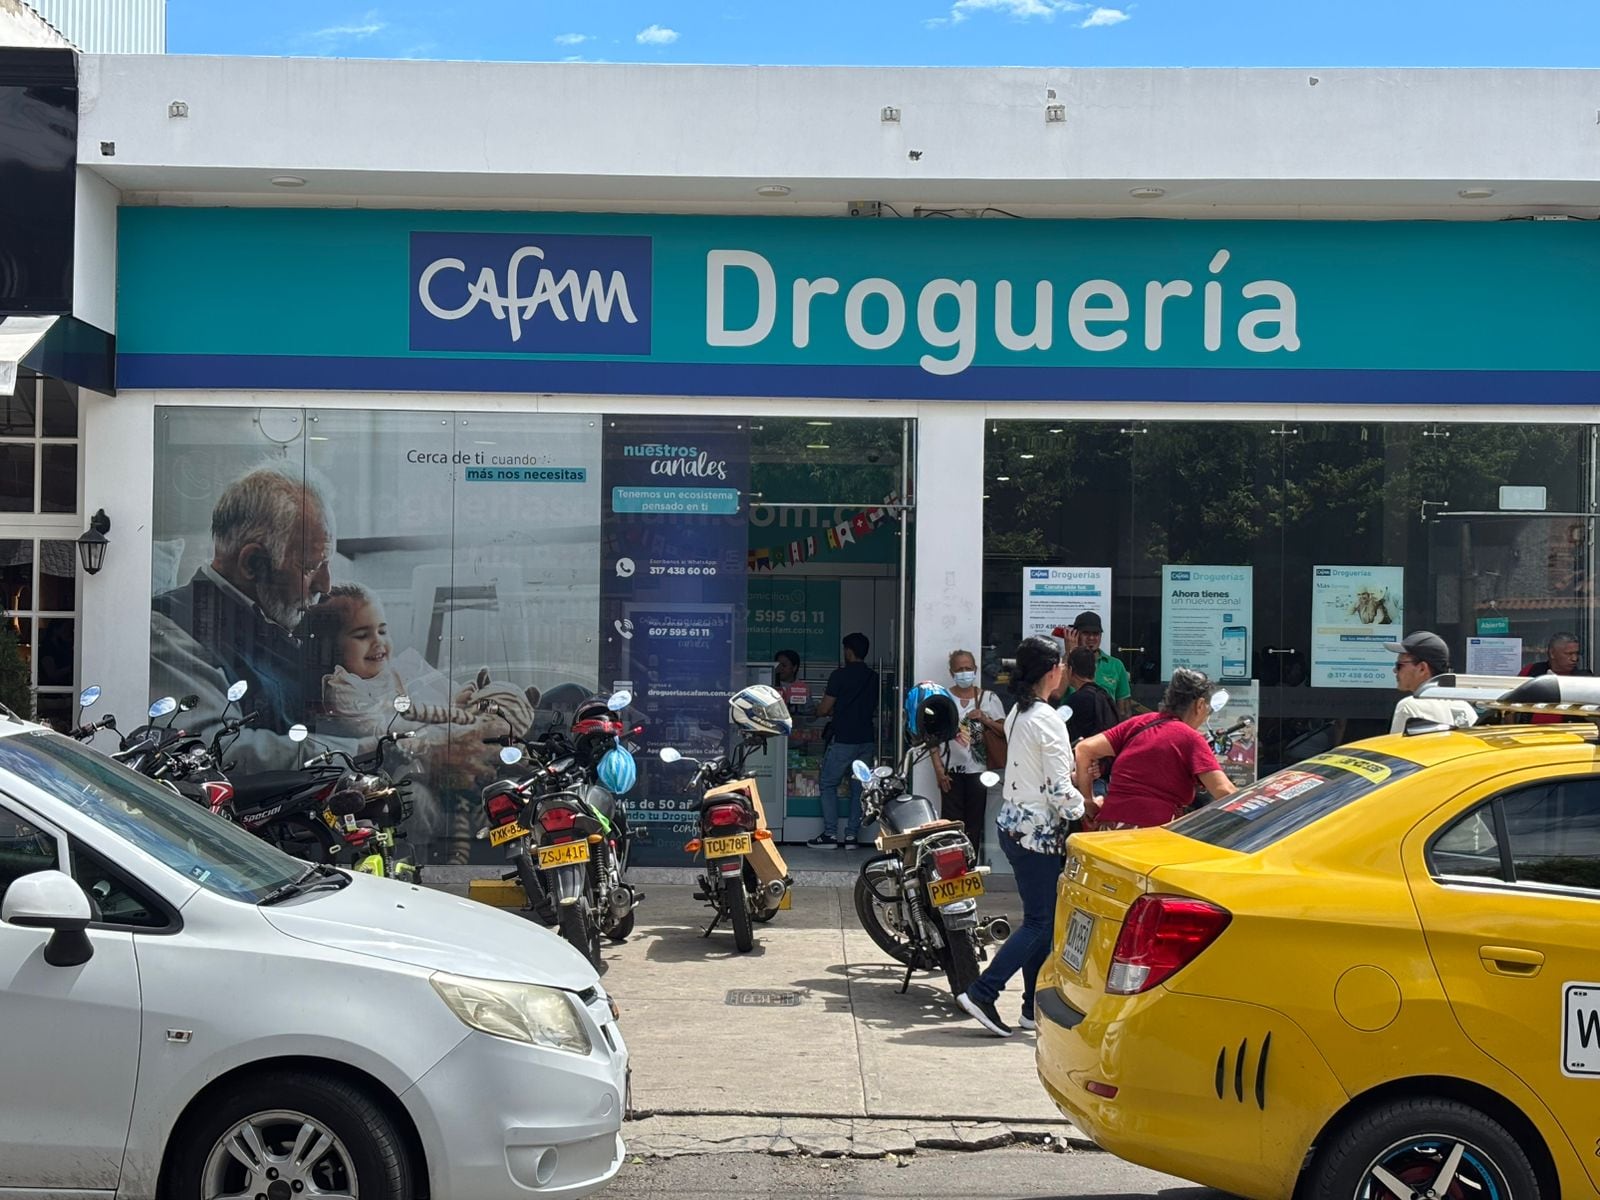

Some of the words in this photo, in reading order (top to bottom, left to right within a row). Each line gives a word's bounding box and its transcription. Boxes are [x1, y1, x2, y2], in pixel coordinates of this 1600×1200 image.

[706, 249, 1300, 375] Droguería
[623, 443, 697, 457] nuestros
[407, 449, 447, 464] Cerca
[452, 450, 471, 464] de
[475, 451, 484, 464] ti
[491, 453, 537, 465] cuando
[650, 451, 728, 480] canales
[467, 468, 493, 479] más
[497, 470, 520, 480] nos
[524, 469, 584, 480] necesitas
[617, 489, 660, 499] Tenemos
[663, 490, 676, 499] un
[678, 489, 733, 500] ecosistema
[642, 501, 685, 512] pensado
[687, 503, 700, 511] en
[701, 502, 708, 511] ti
[649, 566, 665, 575] 317
[667, 566, 686, 575] 438
[687, 566, 701, 575] 60
[702, 566, 717, 575] 00
[1052, 570, 1100, 580] Droguerías
[1333, 569, 1371, 577] Droguerías
[1193, 571, 1244, 582] Droguerías
[1171, 590, 1199, 598] Ahora
[1202, 590, 1229, 598] tienes
[1216, 597, 1241, 605] canal
[755, 610, 785, 622] 595
[790, 610, 806, 623] 61
[811, 611, 825, 623] 11
[648, 627, 668, 637] 607
[669, 627, 687, 637] 595
[688, 628, 699, 637] 61
[701, 628, 710, 637] 11
[639, 799, 655, 809] de
[659, 799, 675, 809] 50
[649, 812, 659, 820] tu
[662, 812, 701, 822] Drogue
